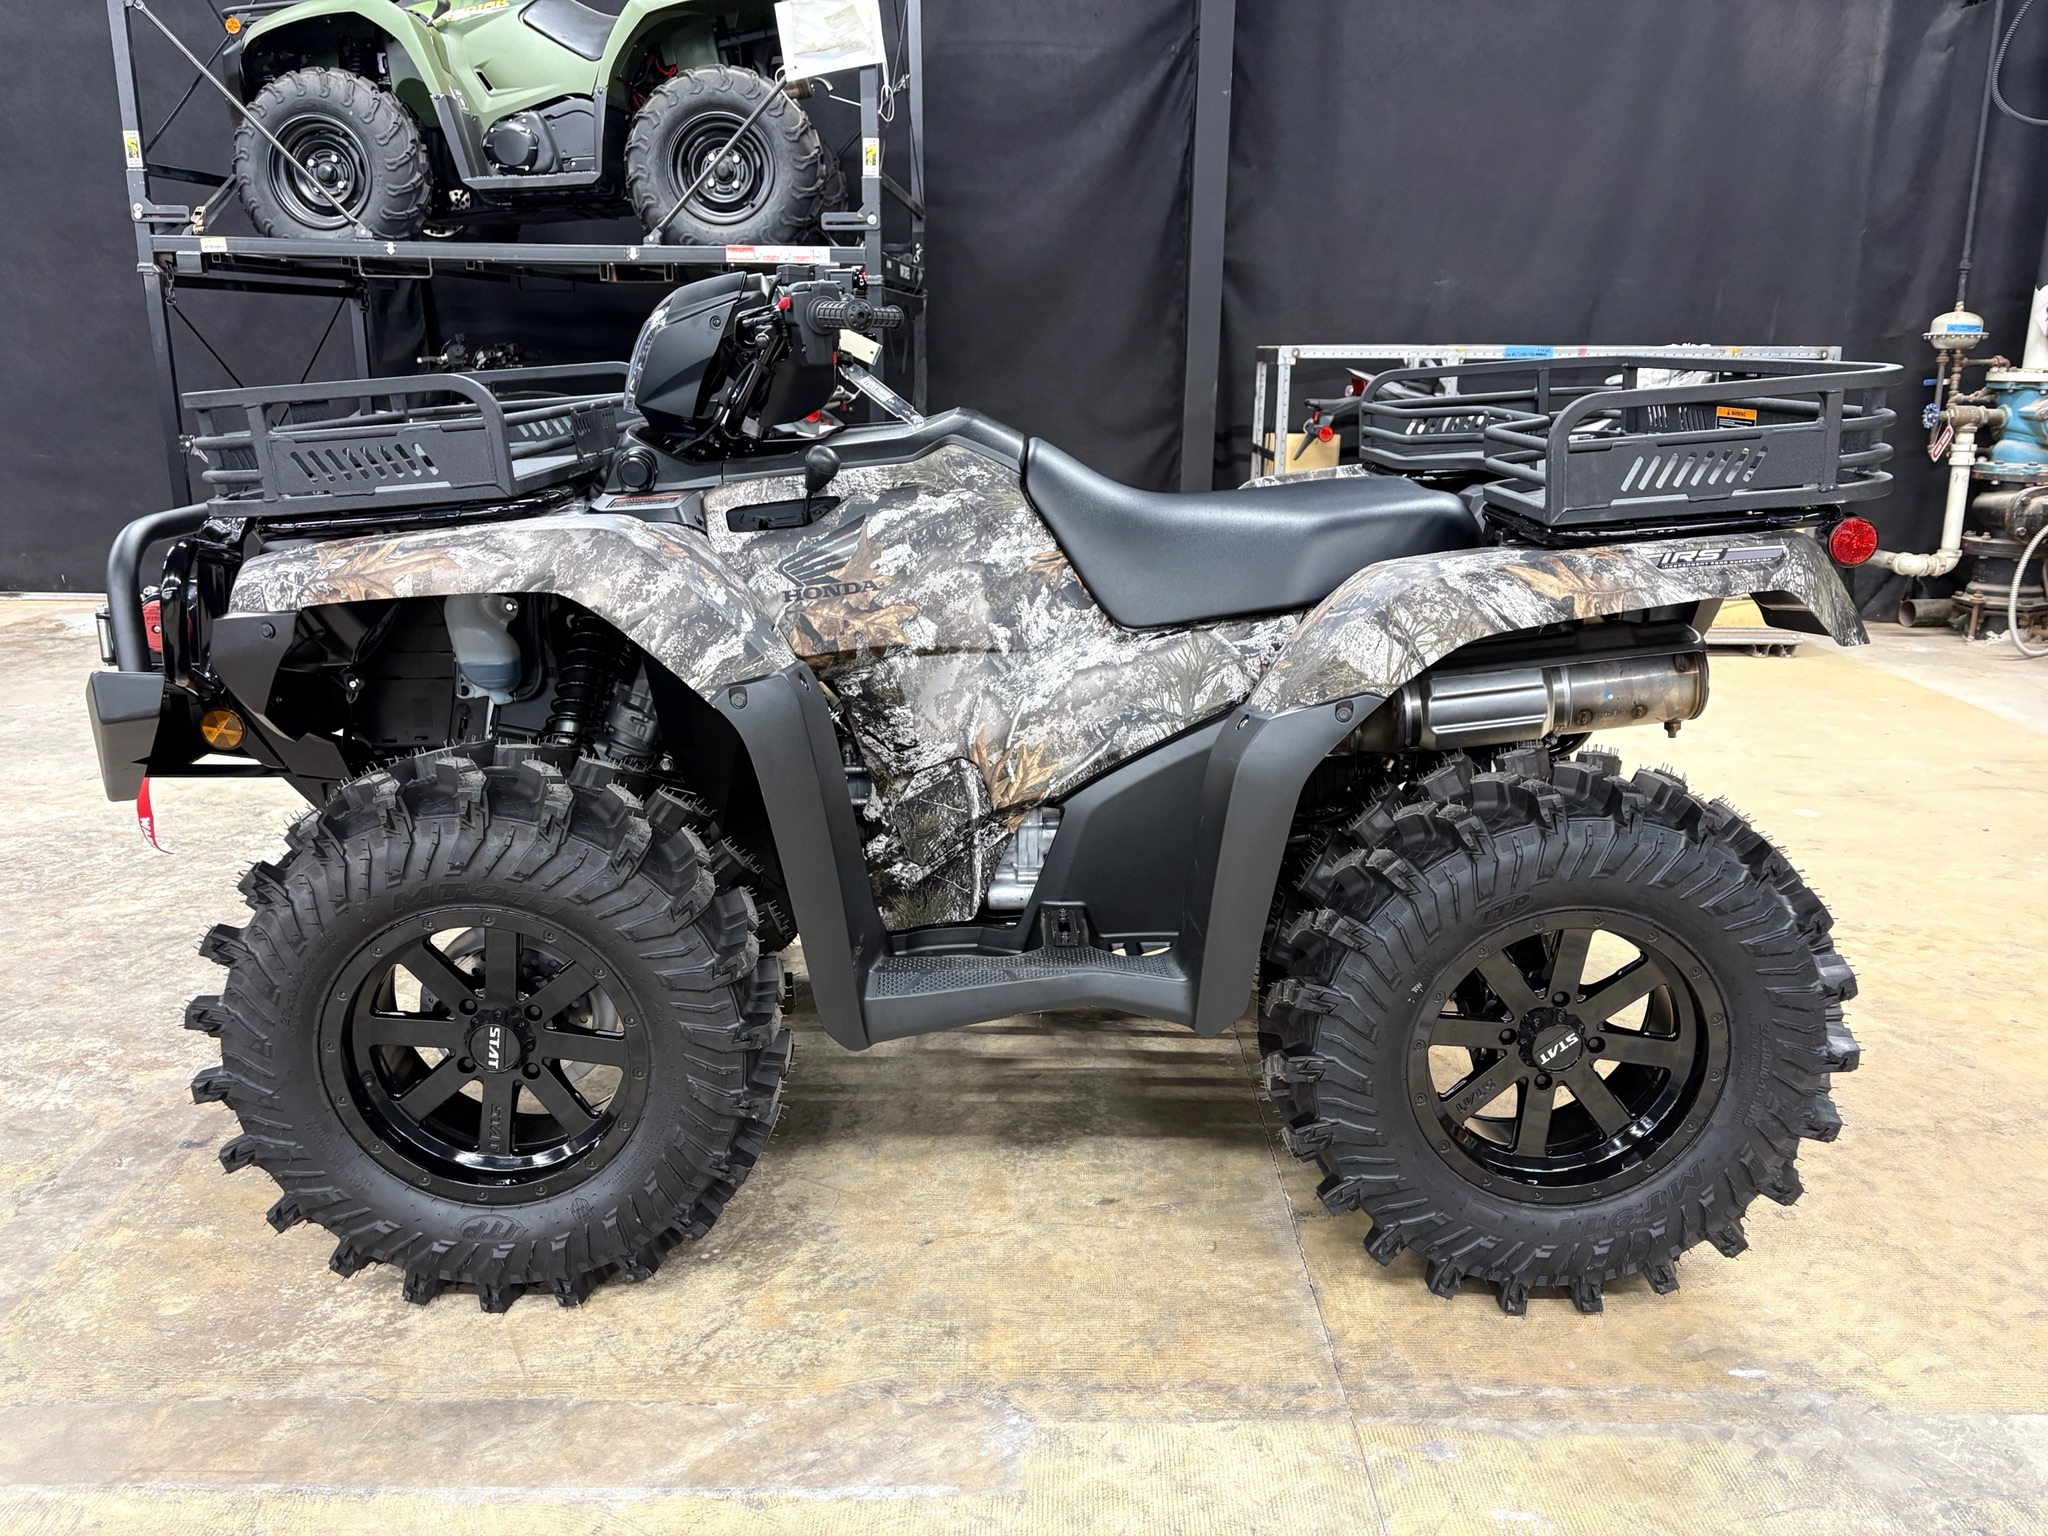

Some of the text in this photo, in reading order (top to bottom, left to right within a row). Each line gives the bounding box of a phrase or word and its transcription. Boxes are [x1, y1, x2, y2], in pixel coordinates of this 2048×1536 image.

[1661, 548, 1723, 564] IRS
[782, 579, 881, 602] HONDA
[393, 881, 566, 916] MT911
[1481, 894, 1530, 923] ITP
[488, 1026, 500, 1069] STAT
[1540, 1032, 1579, 1065] STAT
[1455, 1079, 1497, 1115] STAT
[488, 1103, 502, 1151] STAT
[1557, 1160, 1704, 1237] MT911
[462, 1218, 520, 1240] ITP
